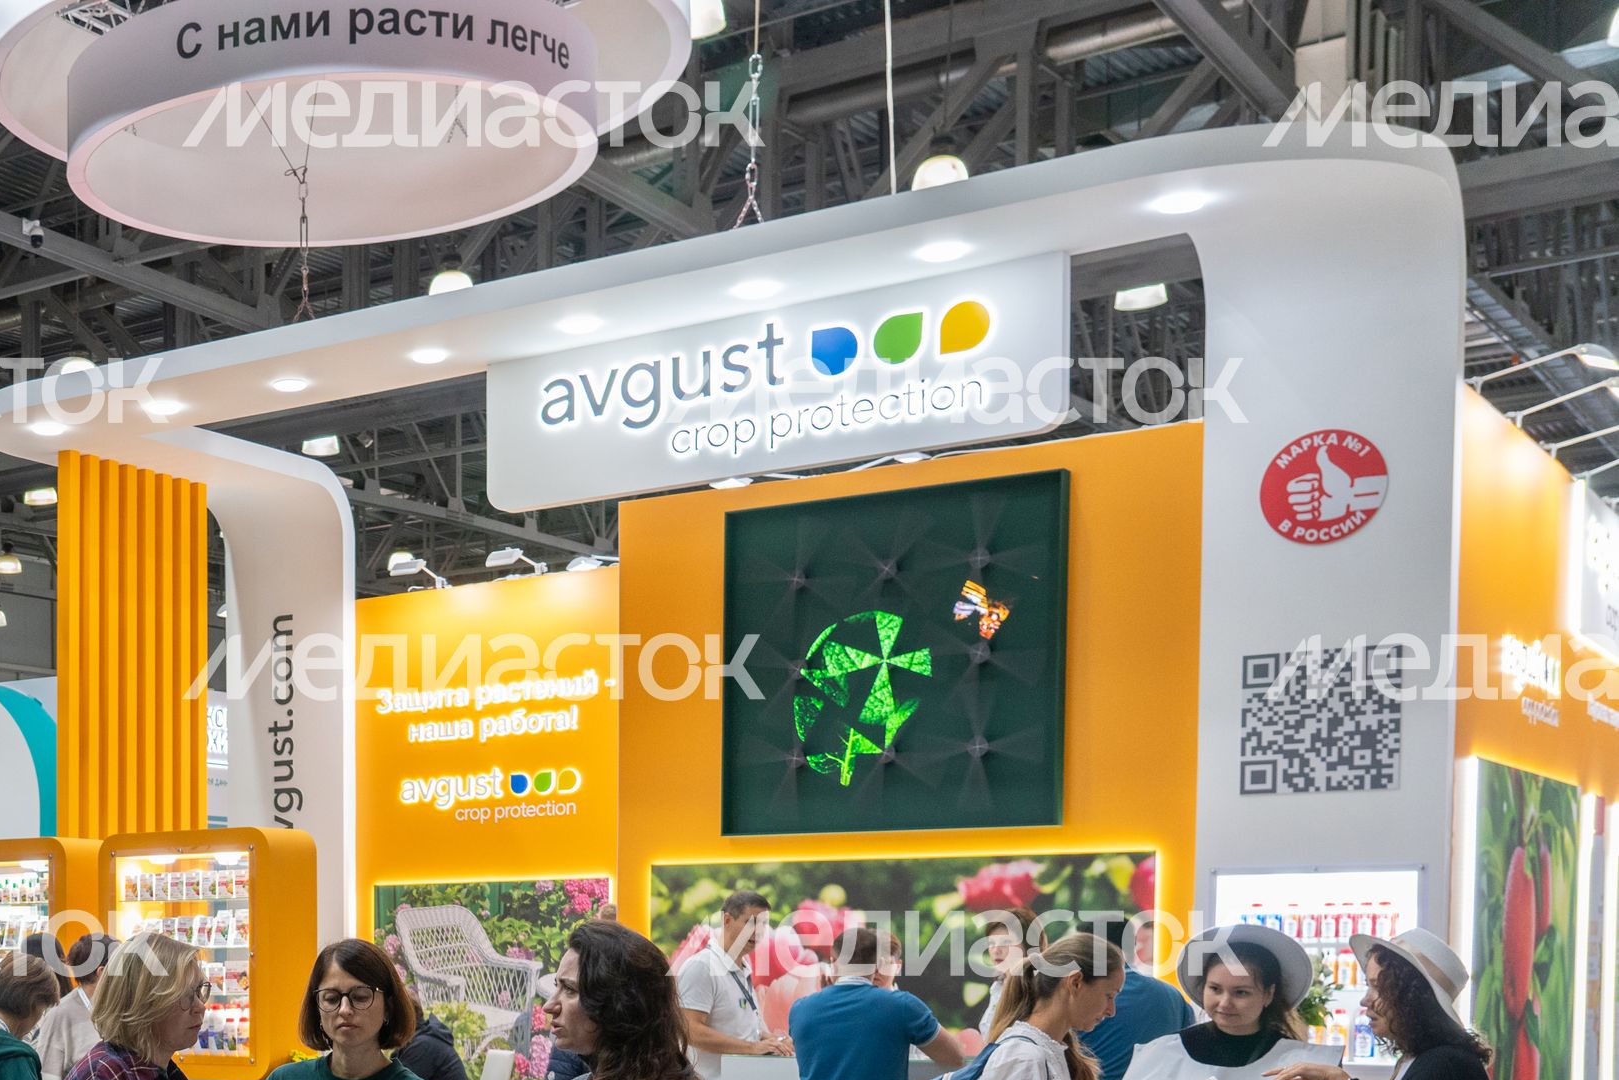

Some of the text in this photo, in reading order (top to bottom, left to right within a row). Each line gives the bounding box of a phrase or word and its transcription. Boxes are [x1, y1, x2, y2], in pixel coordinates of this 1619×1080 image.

[176, 5, 571, 70] С нами расти легче
[541, 323, 785, 431] avgust
[670, 375, 986, 458] crop protection
[1276, 433, 1371, 469] МАРКА №1
[1277, 511, 1367, 541] В РОССИИ
[376, 688, 470, 714] Защита
[475, 668, 599, 710] растений
[408, 705, 579, 742] наша работа!
[400, 767, 503, 810] avgust
[455, 801, 577, 823] crop protection
